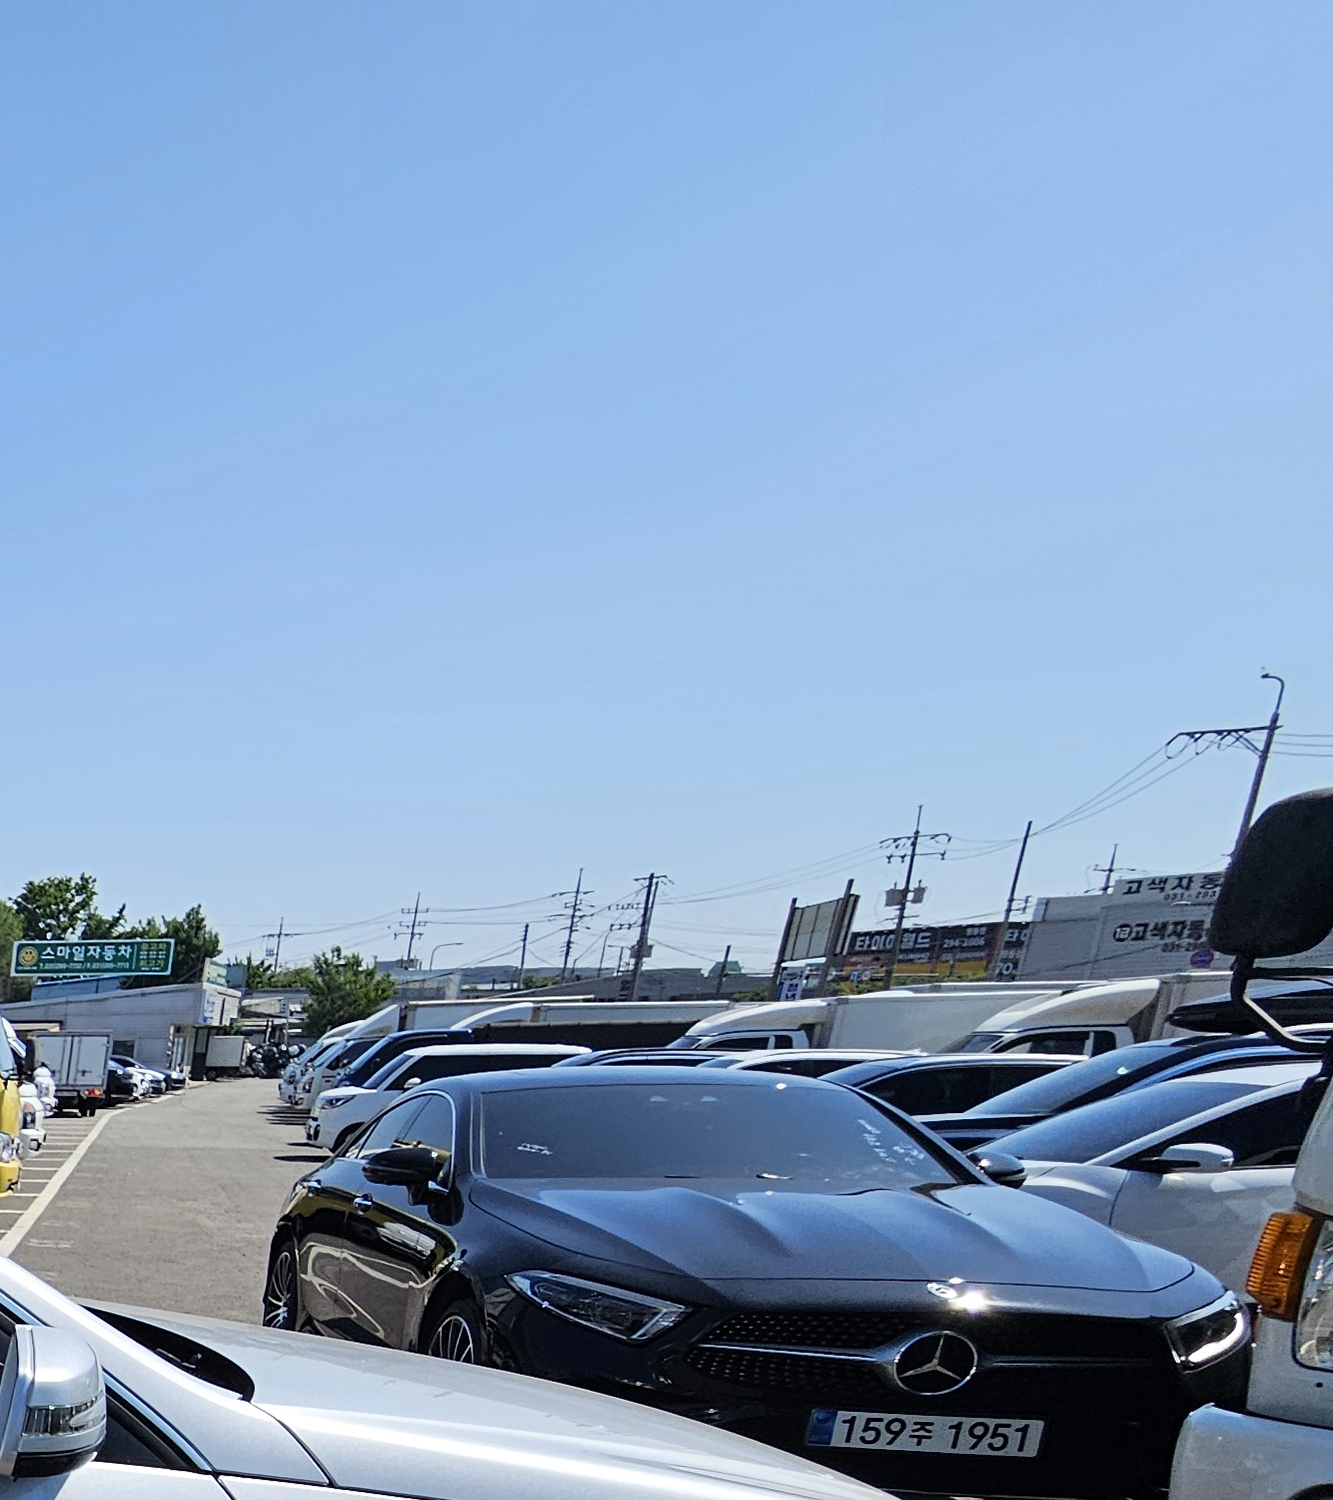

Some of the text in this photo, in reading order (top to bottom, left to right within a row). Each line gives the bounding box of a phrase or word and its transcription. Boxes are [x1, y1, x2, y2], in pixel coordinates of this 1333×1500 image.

[40, 944, 133, 961] 스마일자동차
[841, 1415, 1031, 1453] 159주 1951
